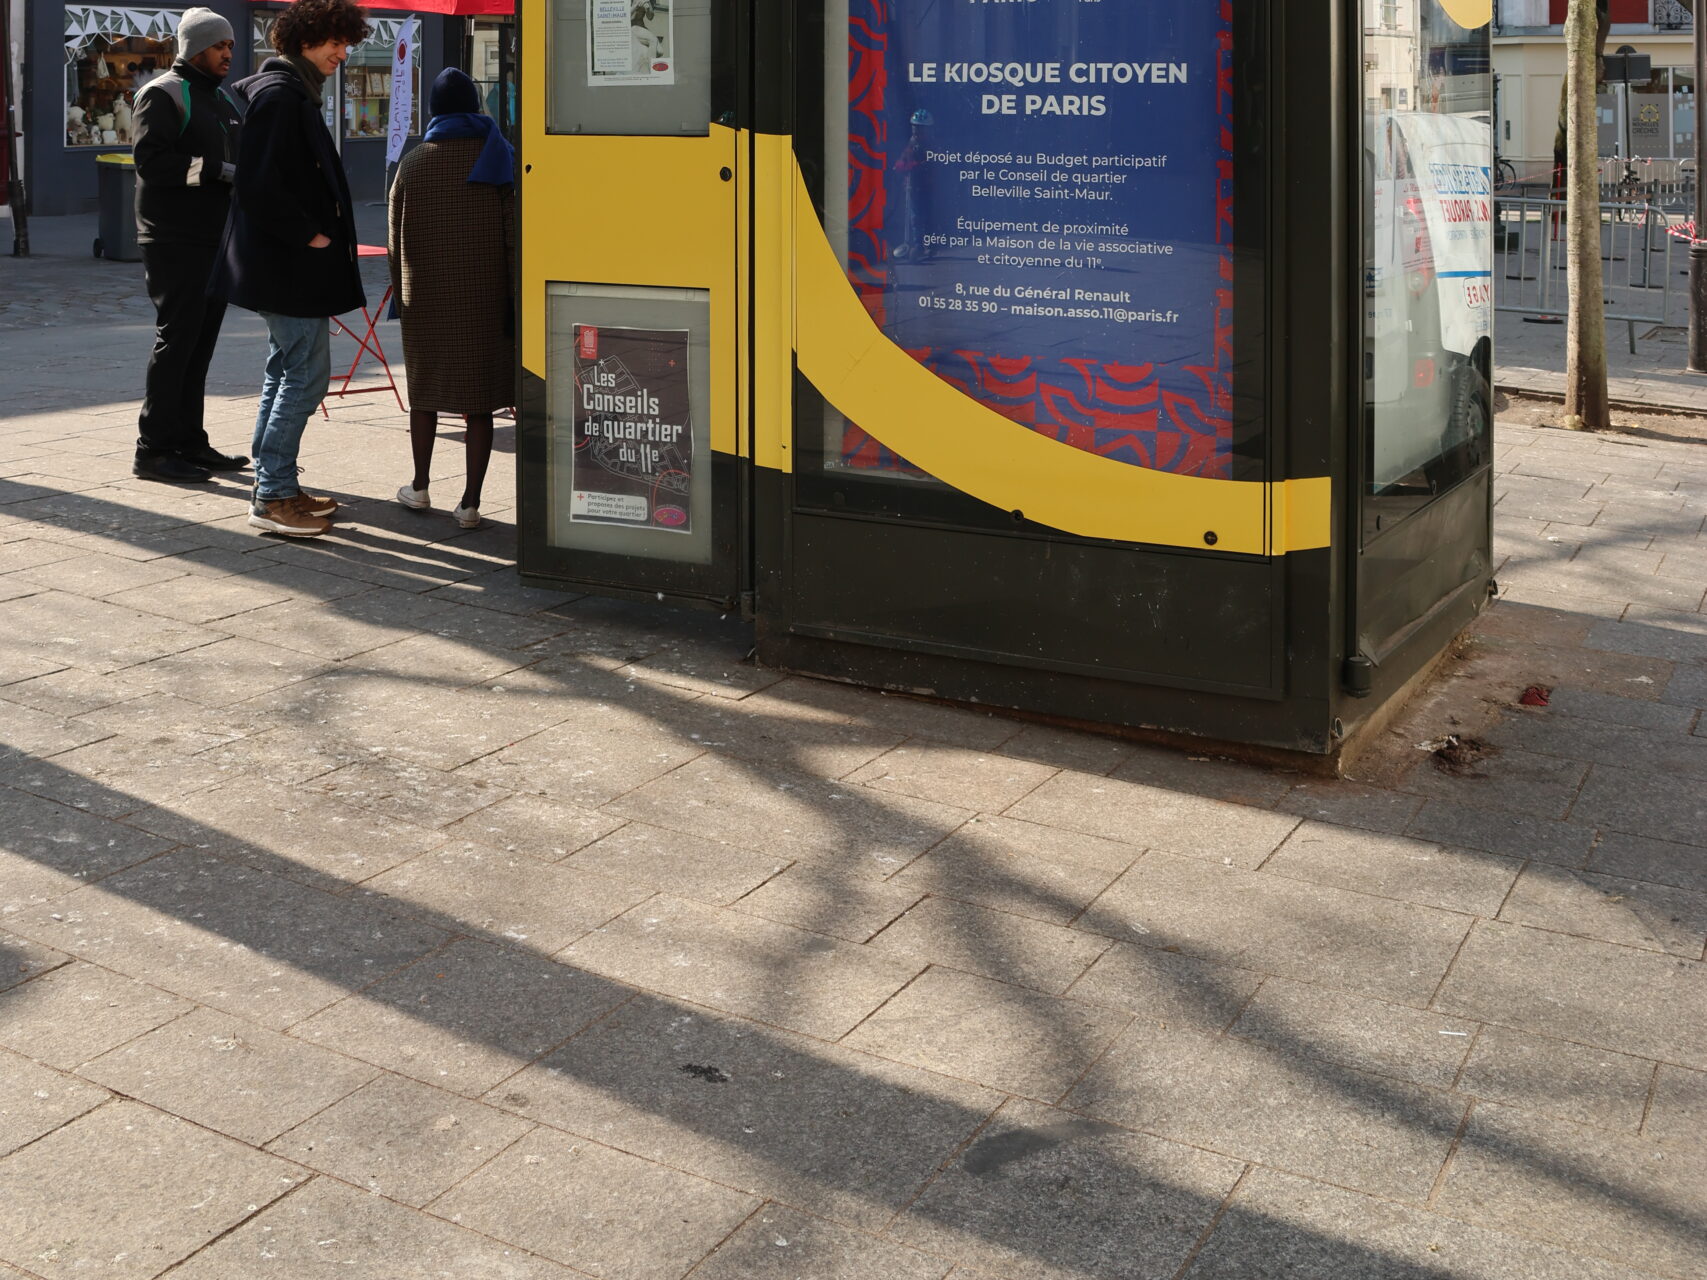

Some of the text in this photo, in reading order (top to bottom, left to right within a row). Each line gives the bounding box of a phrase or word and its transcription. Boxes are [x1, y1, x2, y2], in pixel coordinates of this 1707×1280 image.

[908, 63, 1187, 87] LE KIOSQUE CITOYEN
[982, 95, 1106, 116] DE PARIS
[926, 150, 1167, 169] Projet déposé au Budget participatif
[959, 168, 1127, 185] par le Conseil de quartier
[972, 185, 1112, 201] Belleville Saint-Maur.
[957, 216, 1128, 237] Équipement de proximité
[923, 233, 1173, 255] géré par la Maison de la vie associative
[977, 254, 990, 264] et
[994, 254, 1061, 269] citoyenne
[1065, 256, 1083, 268] du
[955, 282, 1130, 303] 8, rue du Général Renault
[919, 296, 930, 307] 01
[932, 298, 945, 309] 55
[948, 298, 962, 310] 28
[965, 300, 979, 311] 35
[982, 301, 998, 313] 90
[1011, 304, 1179, 324] maison.asso.11@paris.fr
[594, 365, 616, 388] Les
[584, 384, 659, 415] Conseils
[585, 416, 682, 444] de quartier
[619, 442, 636, 462] du
